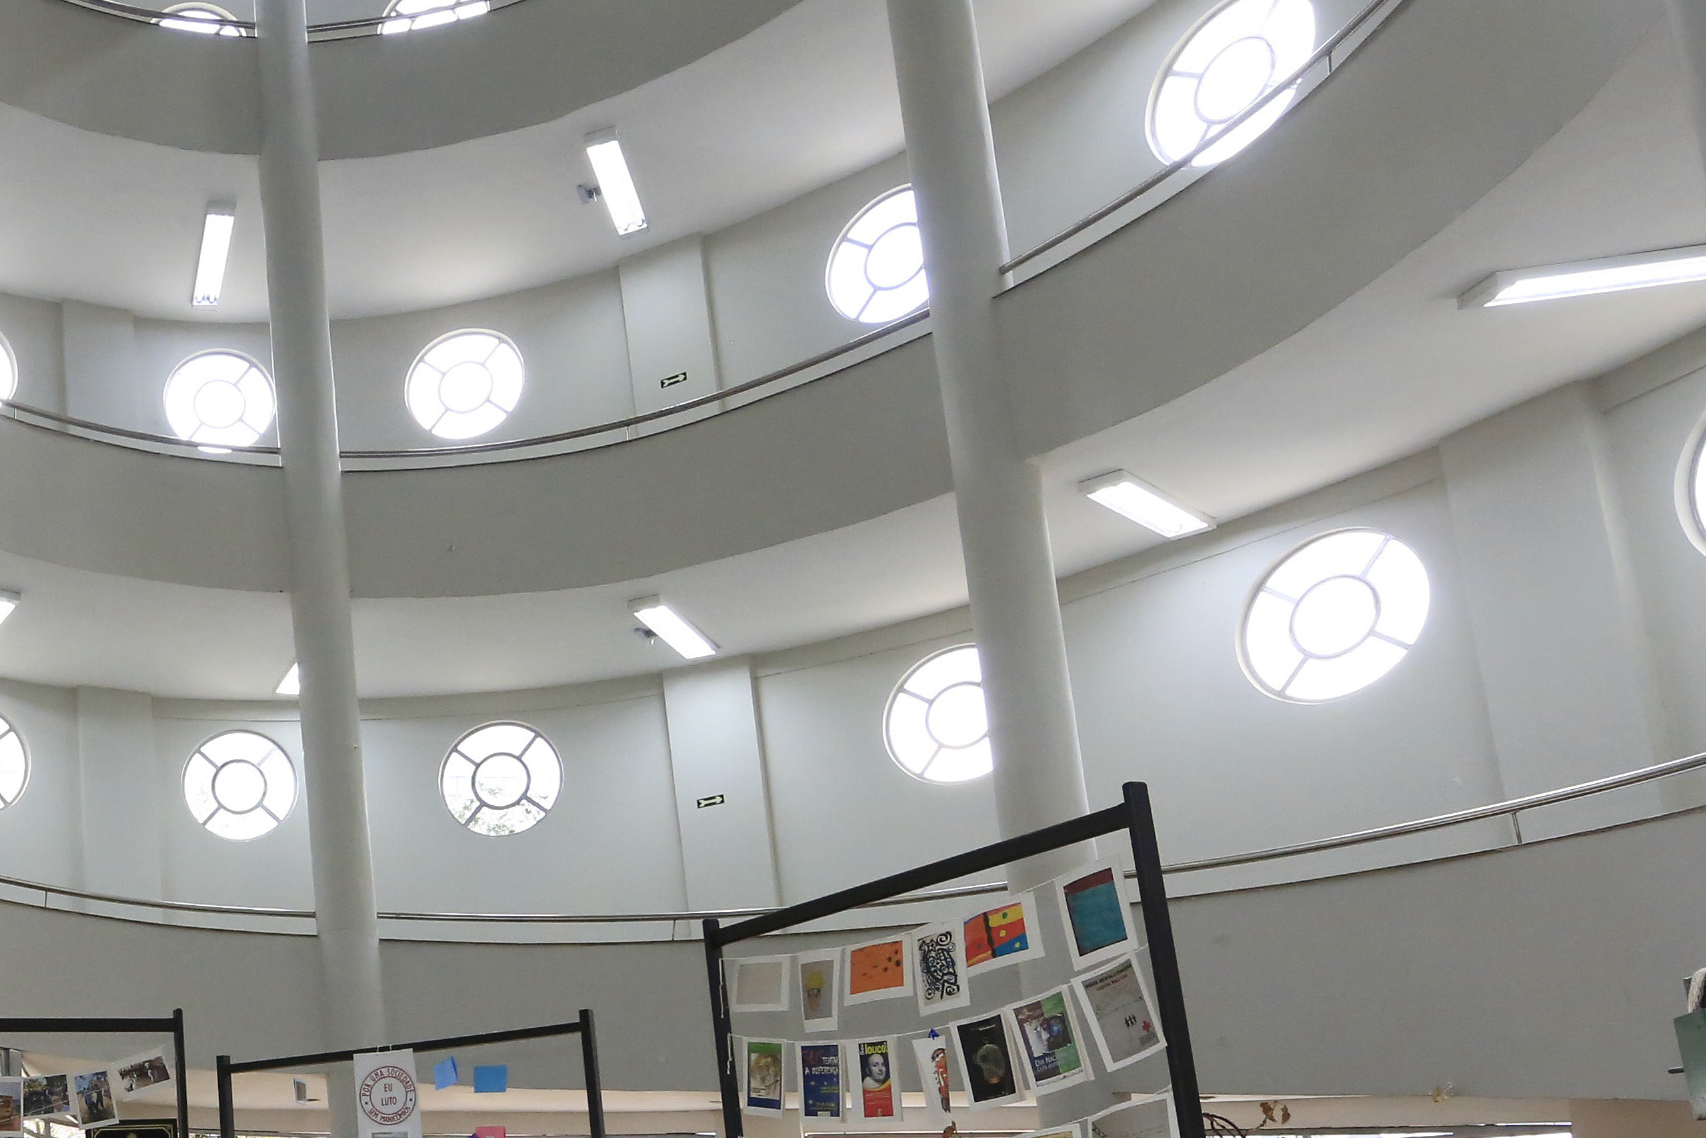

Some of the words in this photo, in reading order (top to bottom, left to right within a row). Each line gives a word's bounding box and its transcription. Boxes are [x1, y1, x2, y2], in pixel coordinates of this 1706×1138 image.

[362, 1083, 372, 1097] POR
[369, 1070, 385, 1082] UMA
[387, 1068, 415, 1093] SOCIEDADE
[384, 1083, 393, 1092] EU
[381, 1096, 397, 1107] LUTO
[367, 1108, 379, 1119] SEM
